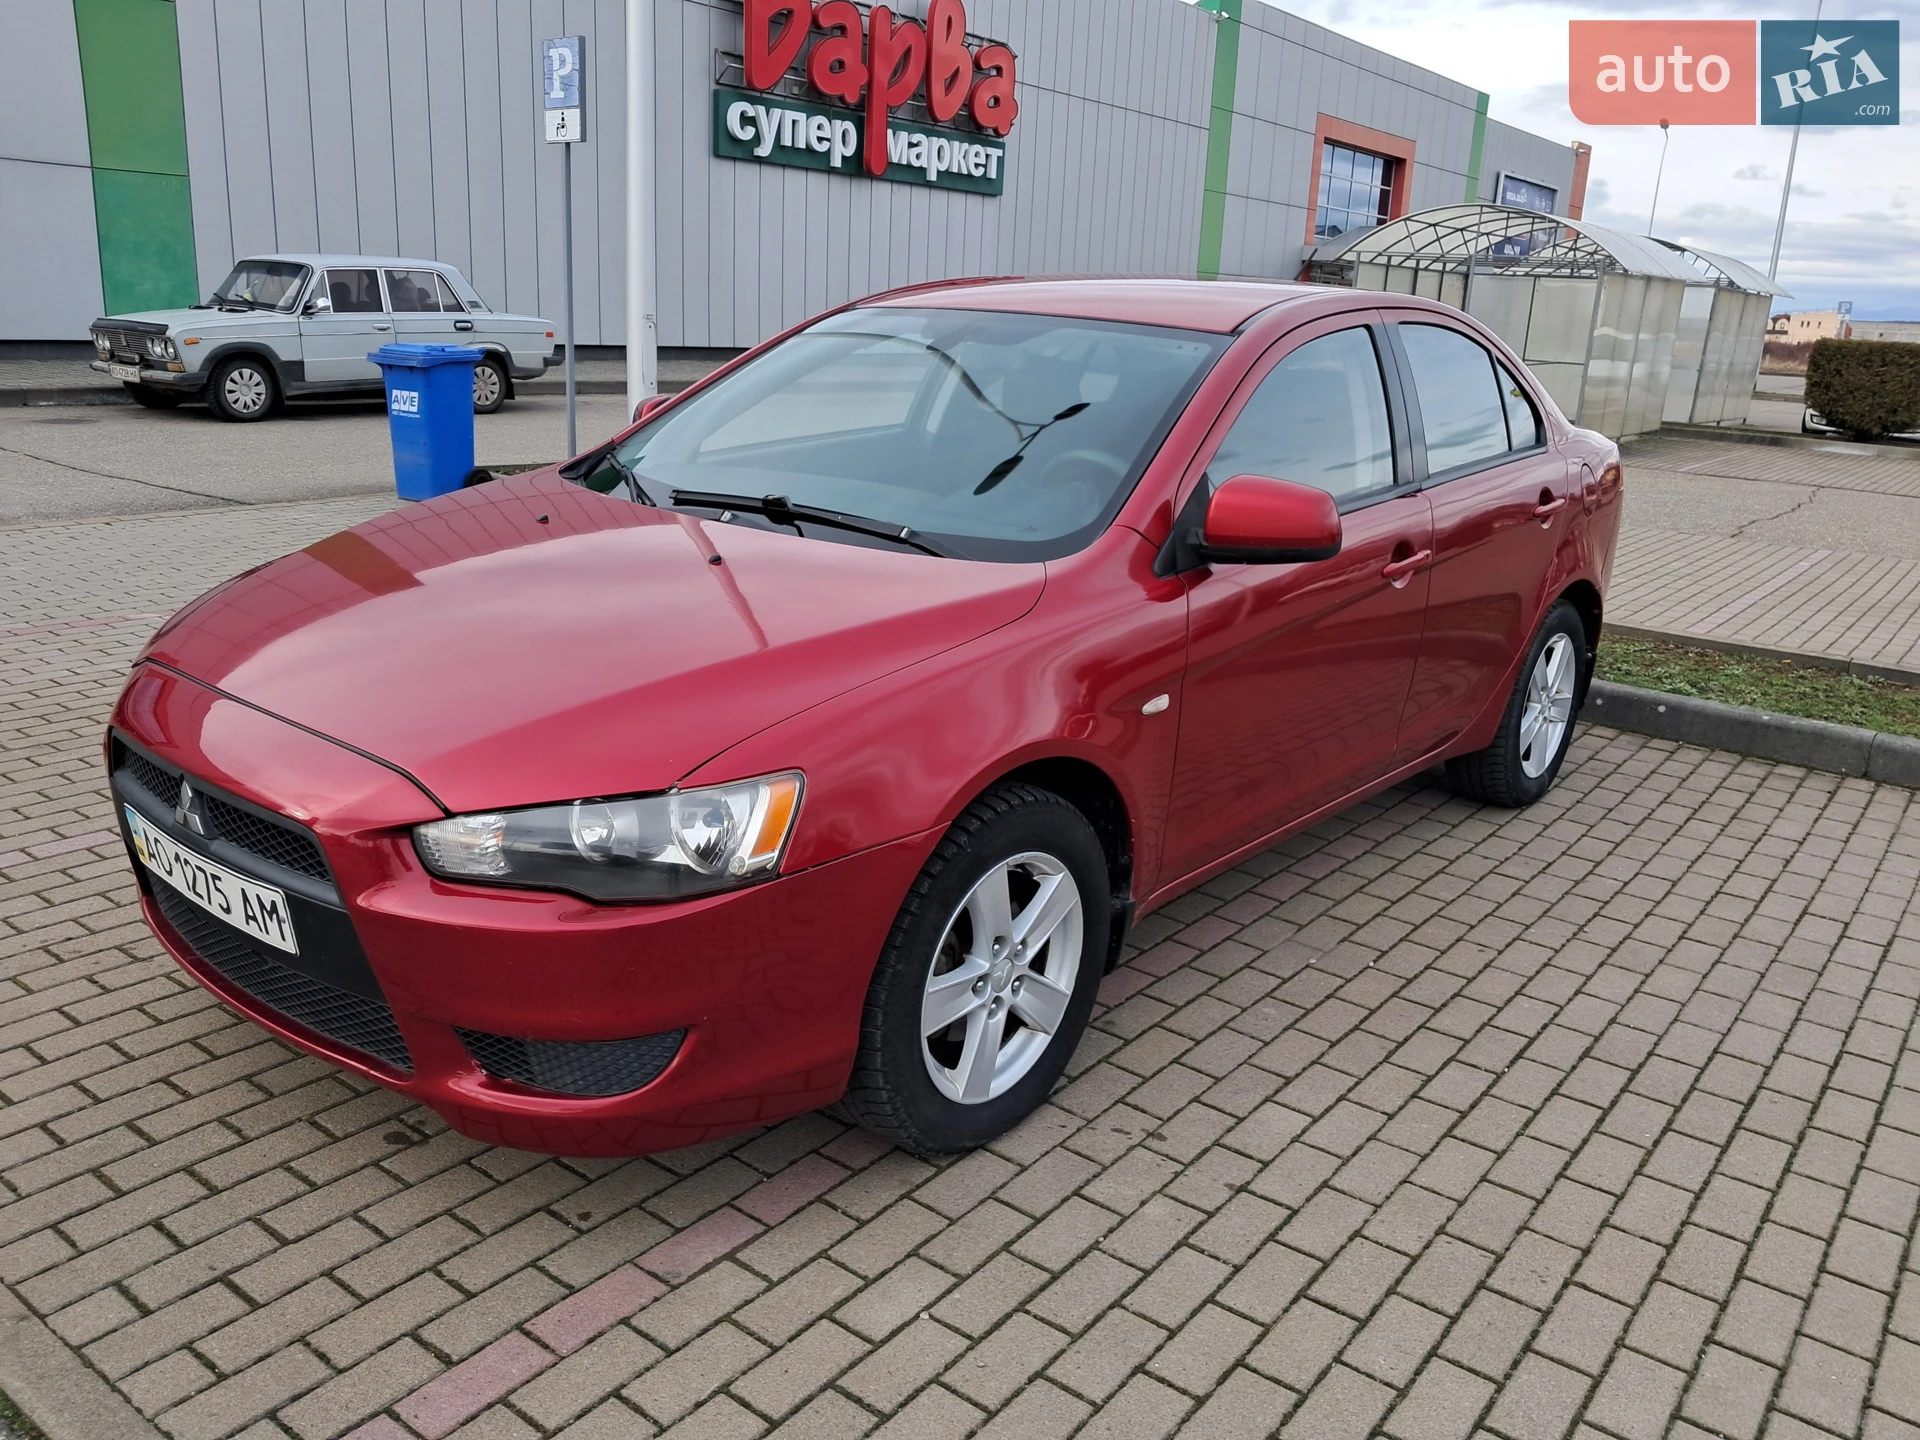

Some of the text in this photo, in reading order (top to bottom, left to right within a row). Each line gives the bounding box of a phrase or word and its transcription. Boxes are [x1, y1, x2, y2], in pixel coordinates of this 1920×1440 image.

[549, 47, 573, 99] P
[726, 100, 1004, 182] супер маркет
[392, 394, 417, 408] AVE
[142, 826, 287, 942] AO 1275 AM
